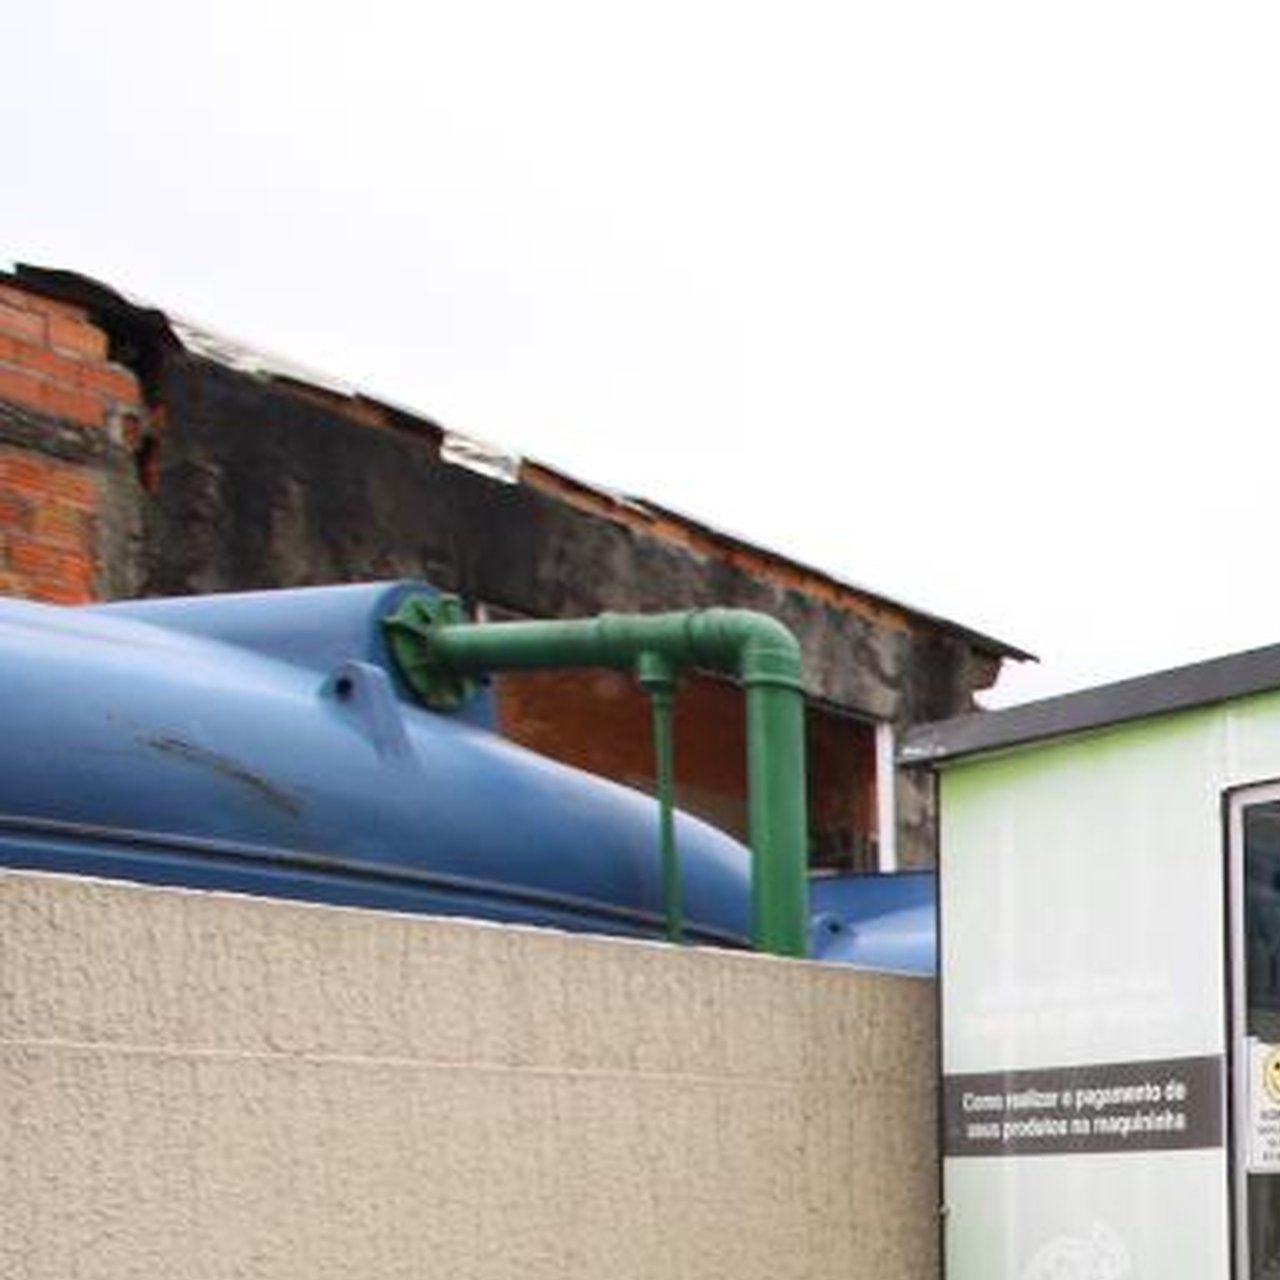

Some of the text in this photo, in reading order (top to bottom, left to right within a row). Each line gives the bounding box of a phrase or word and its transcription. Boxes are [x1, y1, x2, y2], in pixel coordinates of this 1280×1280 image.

[963, 1092, 1003, 1111] Como
[1074, 1083, 1161, 1113] pagamento
[1164, 1079, 1187, 1101] de
[1003, 1117, 1068, 1141] produtos
